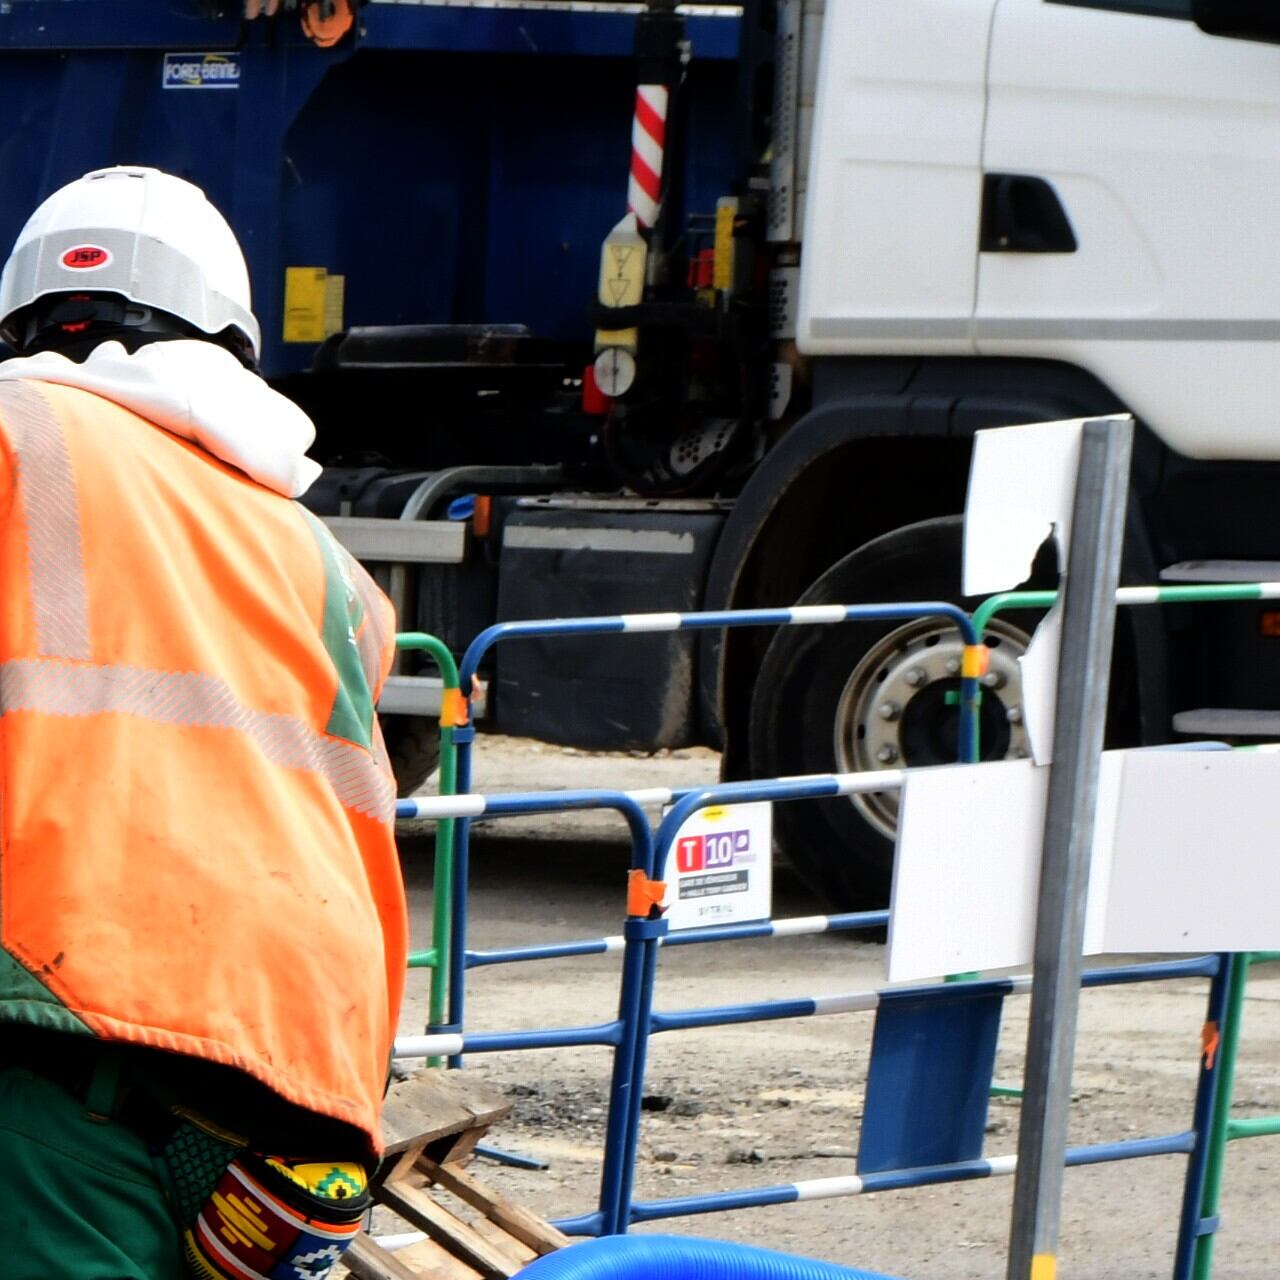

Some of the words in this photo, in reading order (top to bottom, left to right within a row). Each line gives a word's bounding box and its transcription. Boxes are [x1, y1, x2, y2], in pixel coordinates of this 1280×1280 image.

[70, 251, 101, 263] JSP
[682, 840, 698, 868] T
[706, 836, 733, 865] 10
